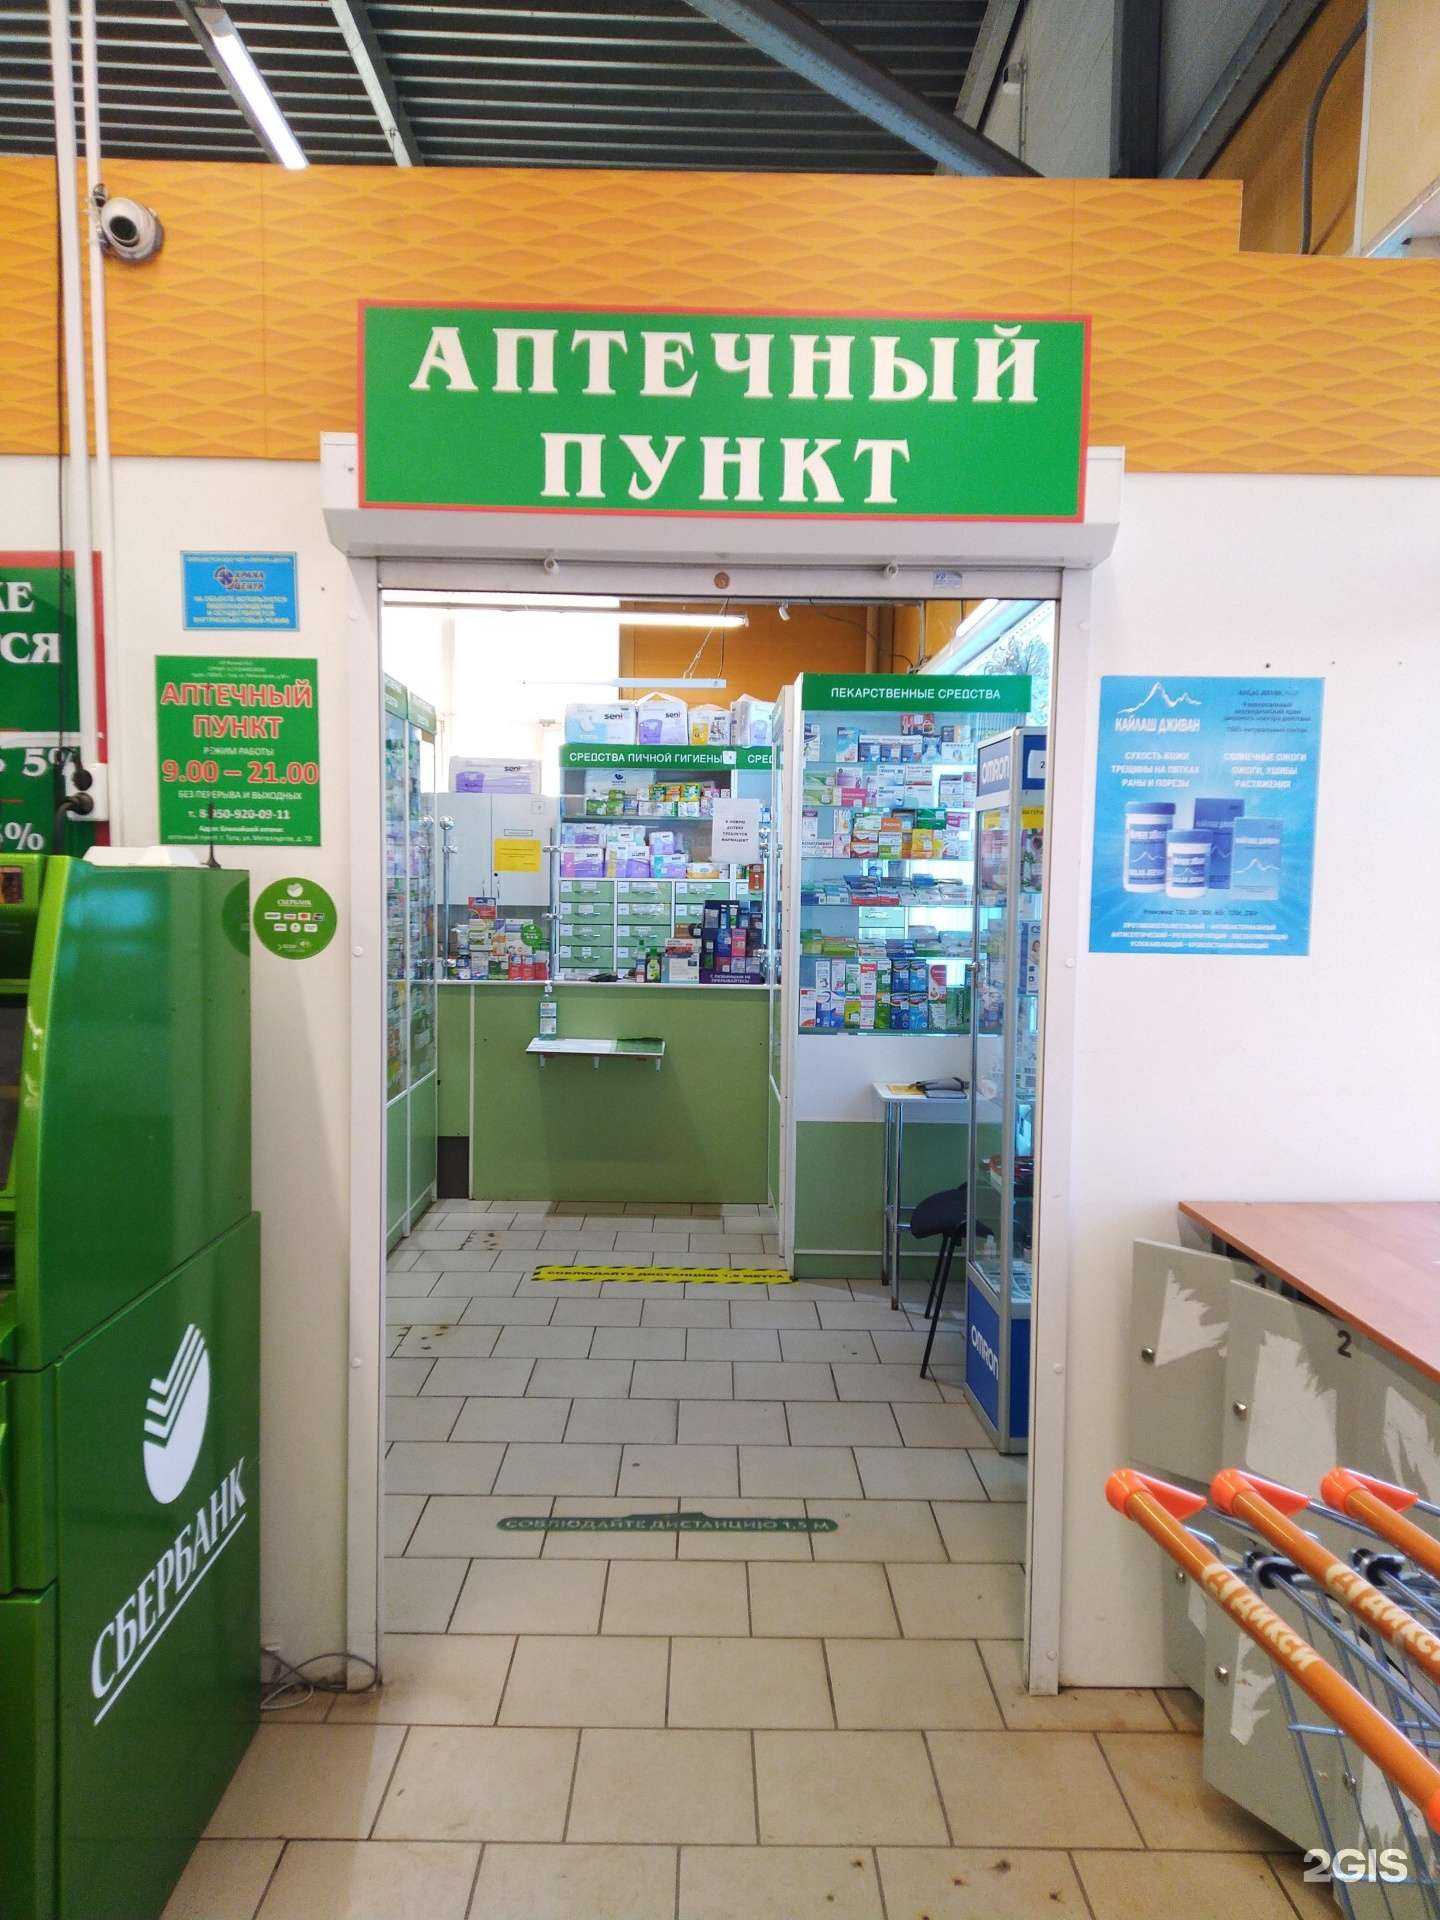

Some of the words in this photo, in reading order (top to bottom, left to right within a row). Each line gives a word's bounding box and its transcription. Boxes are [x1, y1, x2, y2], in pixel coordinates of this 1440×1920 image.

[409, 325, 1040, 402] АПТЕЧНЫЙ
[540, 432, 911, 504] ПУНКТ
[0, 632, 61, 664] СЯ
[160, 679, 313, 708] АПТЕЧНЫЙ
[831, 687, 935, 699] ЛЕКАРСТВЕННЫЕ
[938, 688, 1001, 700] СРЕДСТВА
[193, 715, 284, 739] ПУНКТ
[604, 712, 623, 720] seni
[1115, 714, 1157, 732] КАЙЛАШ
[1159, 717, 1201, 734] ДЖИВАН
[239, 747, 274, 756] РАБОТЫ
[569, 752, 625, 763] СРЕДСТВА
[628, 751, 672, 764] ЛИЧНОЙ
[675, 753, 723, 765] ГИГИЕНЫ
[161, 759, 219, 783] 9.00
[247, 761, 319, 784] 21.00
[178, 790, 193, 798] БЕЗ
[252, 792, 303, 801] ВЫХОДНЫХ
[1337, 1330, 1352, 1359] 2
[505, 1518, 647, 1530] СОБЛЮДАЙТЕ
[650, 1519, 778, 1531] ДИСТАНЦИЮ
[91, 1457, 246, 1698] СБЕРБАНК
